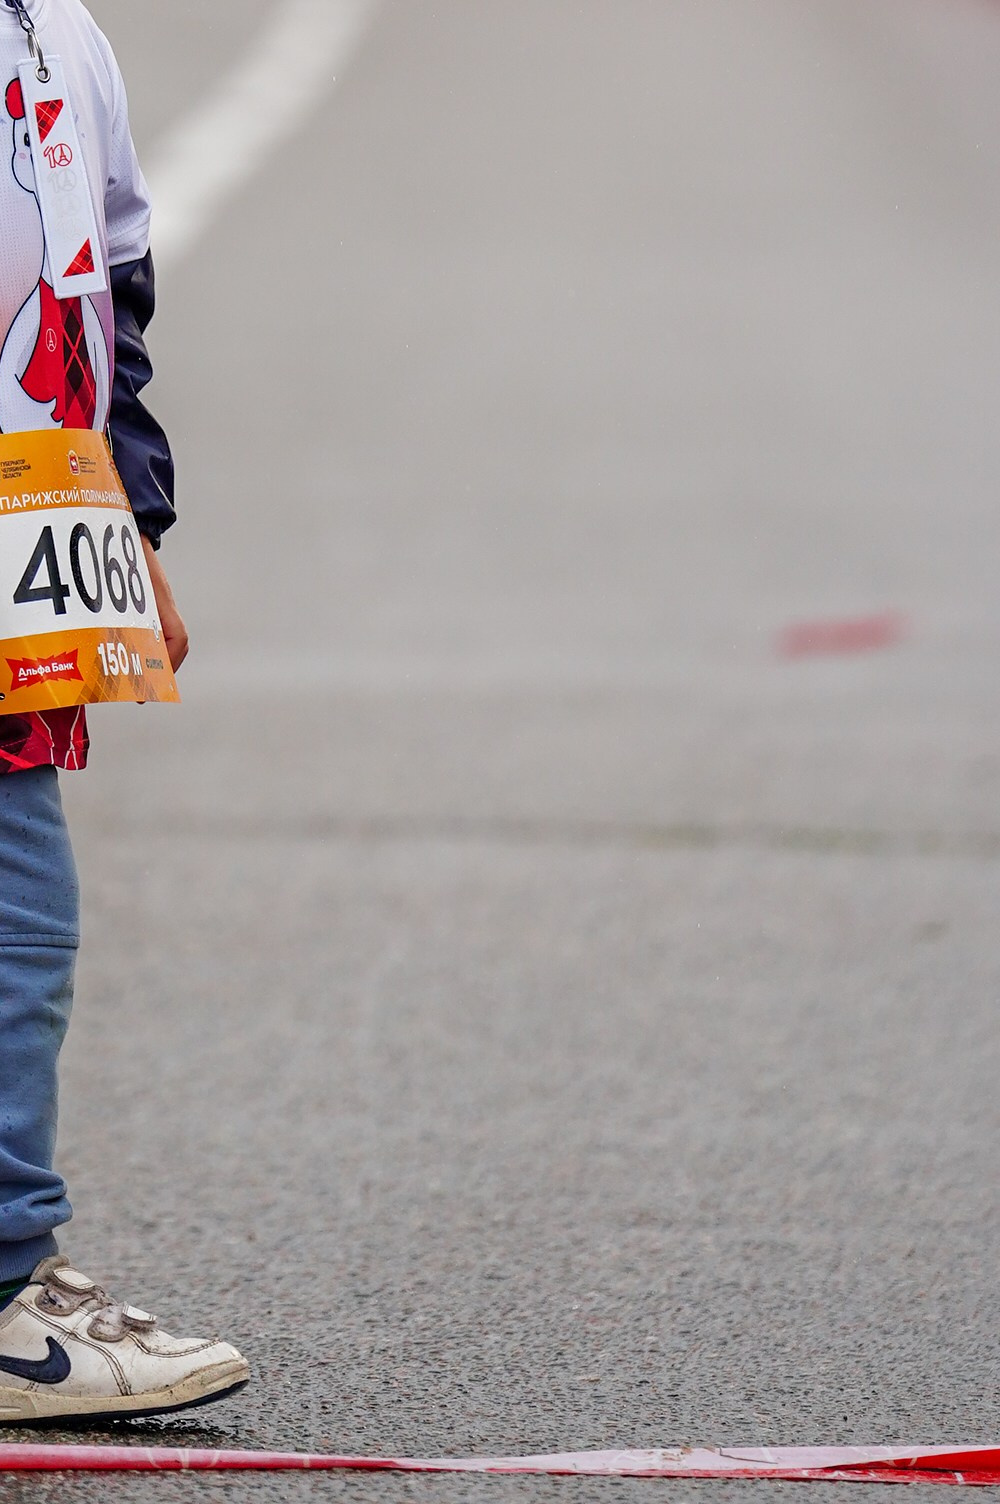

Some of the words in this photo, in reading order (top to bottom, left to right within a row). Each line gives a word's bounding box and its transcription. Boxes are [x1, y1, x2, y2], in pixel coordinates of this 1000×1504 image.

[0, 487, 80, 511] ПАРИЖСКИЙ
[13, 522, 146, 616] 4068
[18, 664, 51, 680] Альфа
[51, 662, 75, 673] Банк
[97, 642, 130, 676] 150
